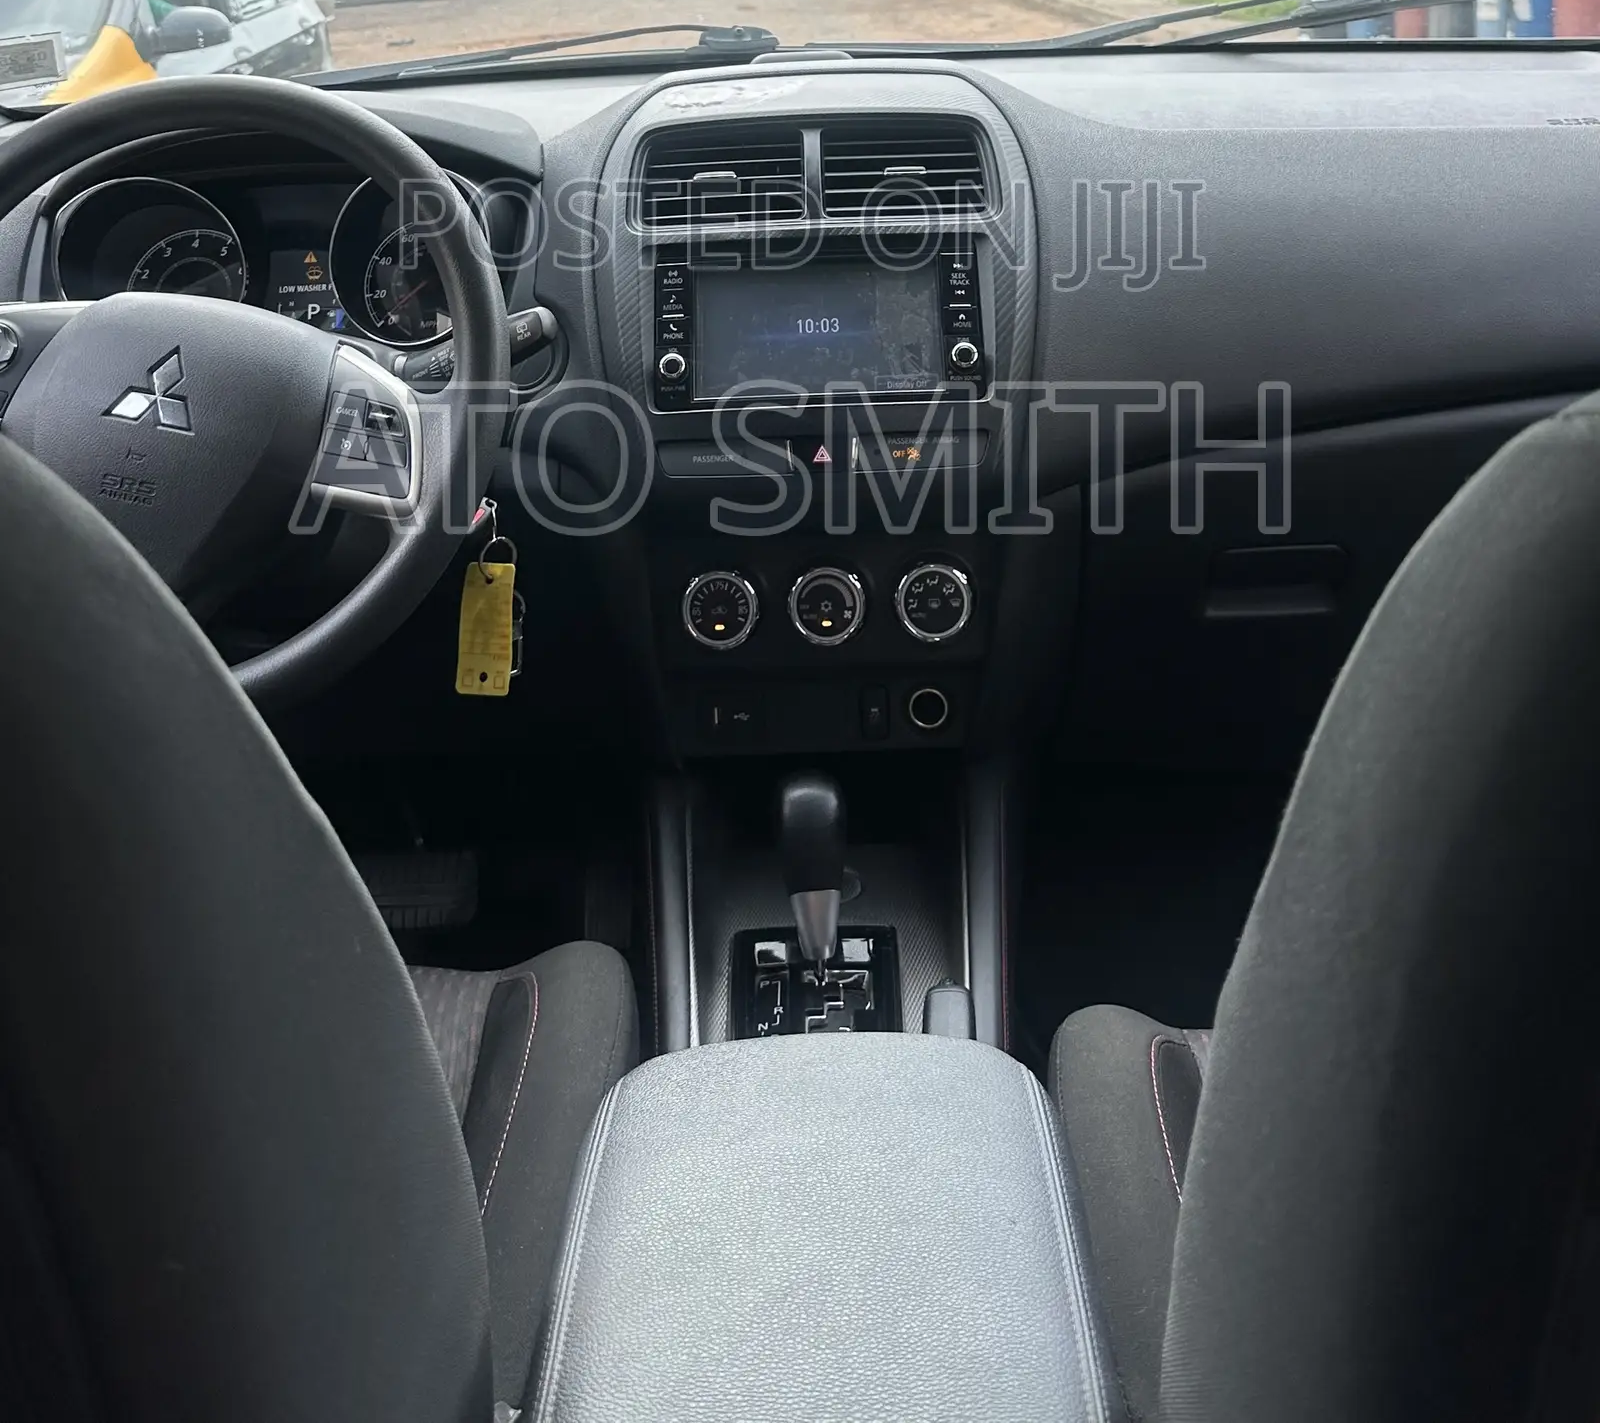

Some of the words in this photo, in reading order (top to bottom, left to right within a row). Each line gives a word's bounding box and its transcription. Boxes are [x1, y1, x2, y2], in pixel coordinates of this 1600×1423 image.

[191, 238, 200, 249] 4
[401, 234, 415, 243] 60
[163, 247, 172, 257] 3
[220, 246, 229, 256] 5
[379, 257, 392, 266] 40
[140, 269, 150, 279] 2
[663, 277, 683, 285] RADIO
[278, 285, 296, 294] LOW
[296, 283, 327, 292] WASHER
[373, 289, 387, 299] 20
[308, 303, 321, 320] P
[796, 316, 840, 334] 10:03
[516, 332, 532, 342] REAR
[886, 381, 915, 390] Display
[916, 379, 928, 388] Off
[336, 406, 359, 417] CANCEL
[692, 454, 734, 463] PASSENGER
[892, 450, 906, 458] OFF
[100, 473, 157, 498] SRS
[99, 488, 153, 507] AIRBAG
[773, 1006, 784, 1014] R
[758, 1022, 769, 1031] N
